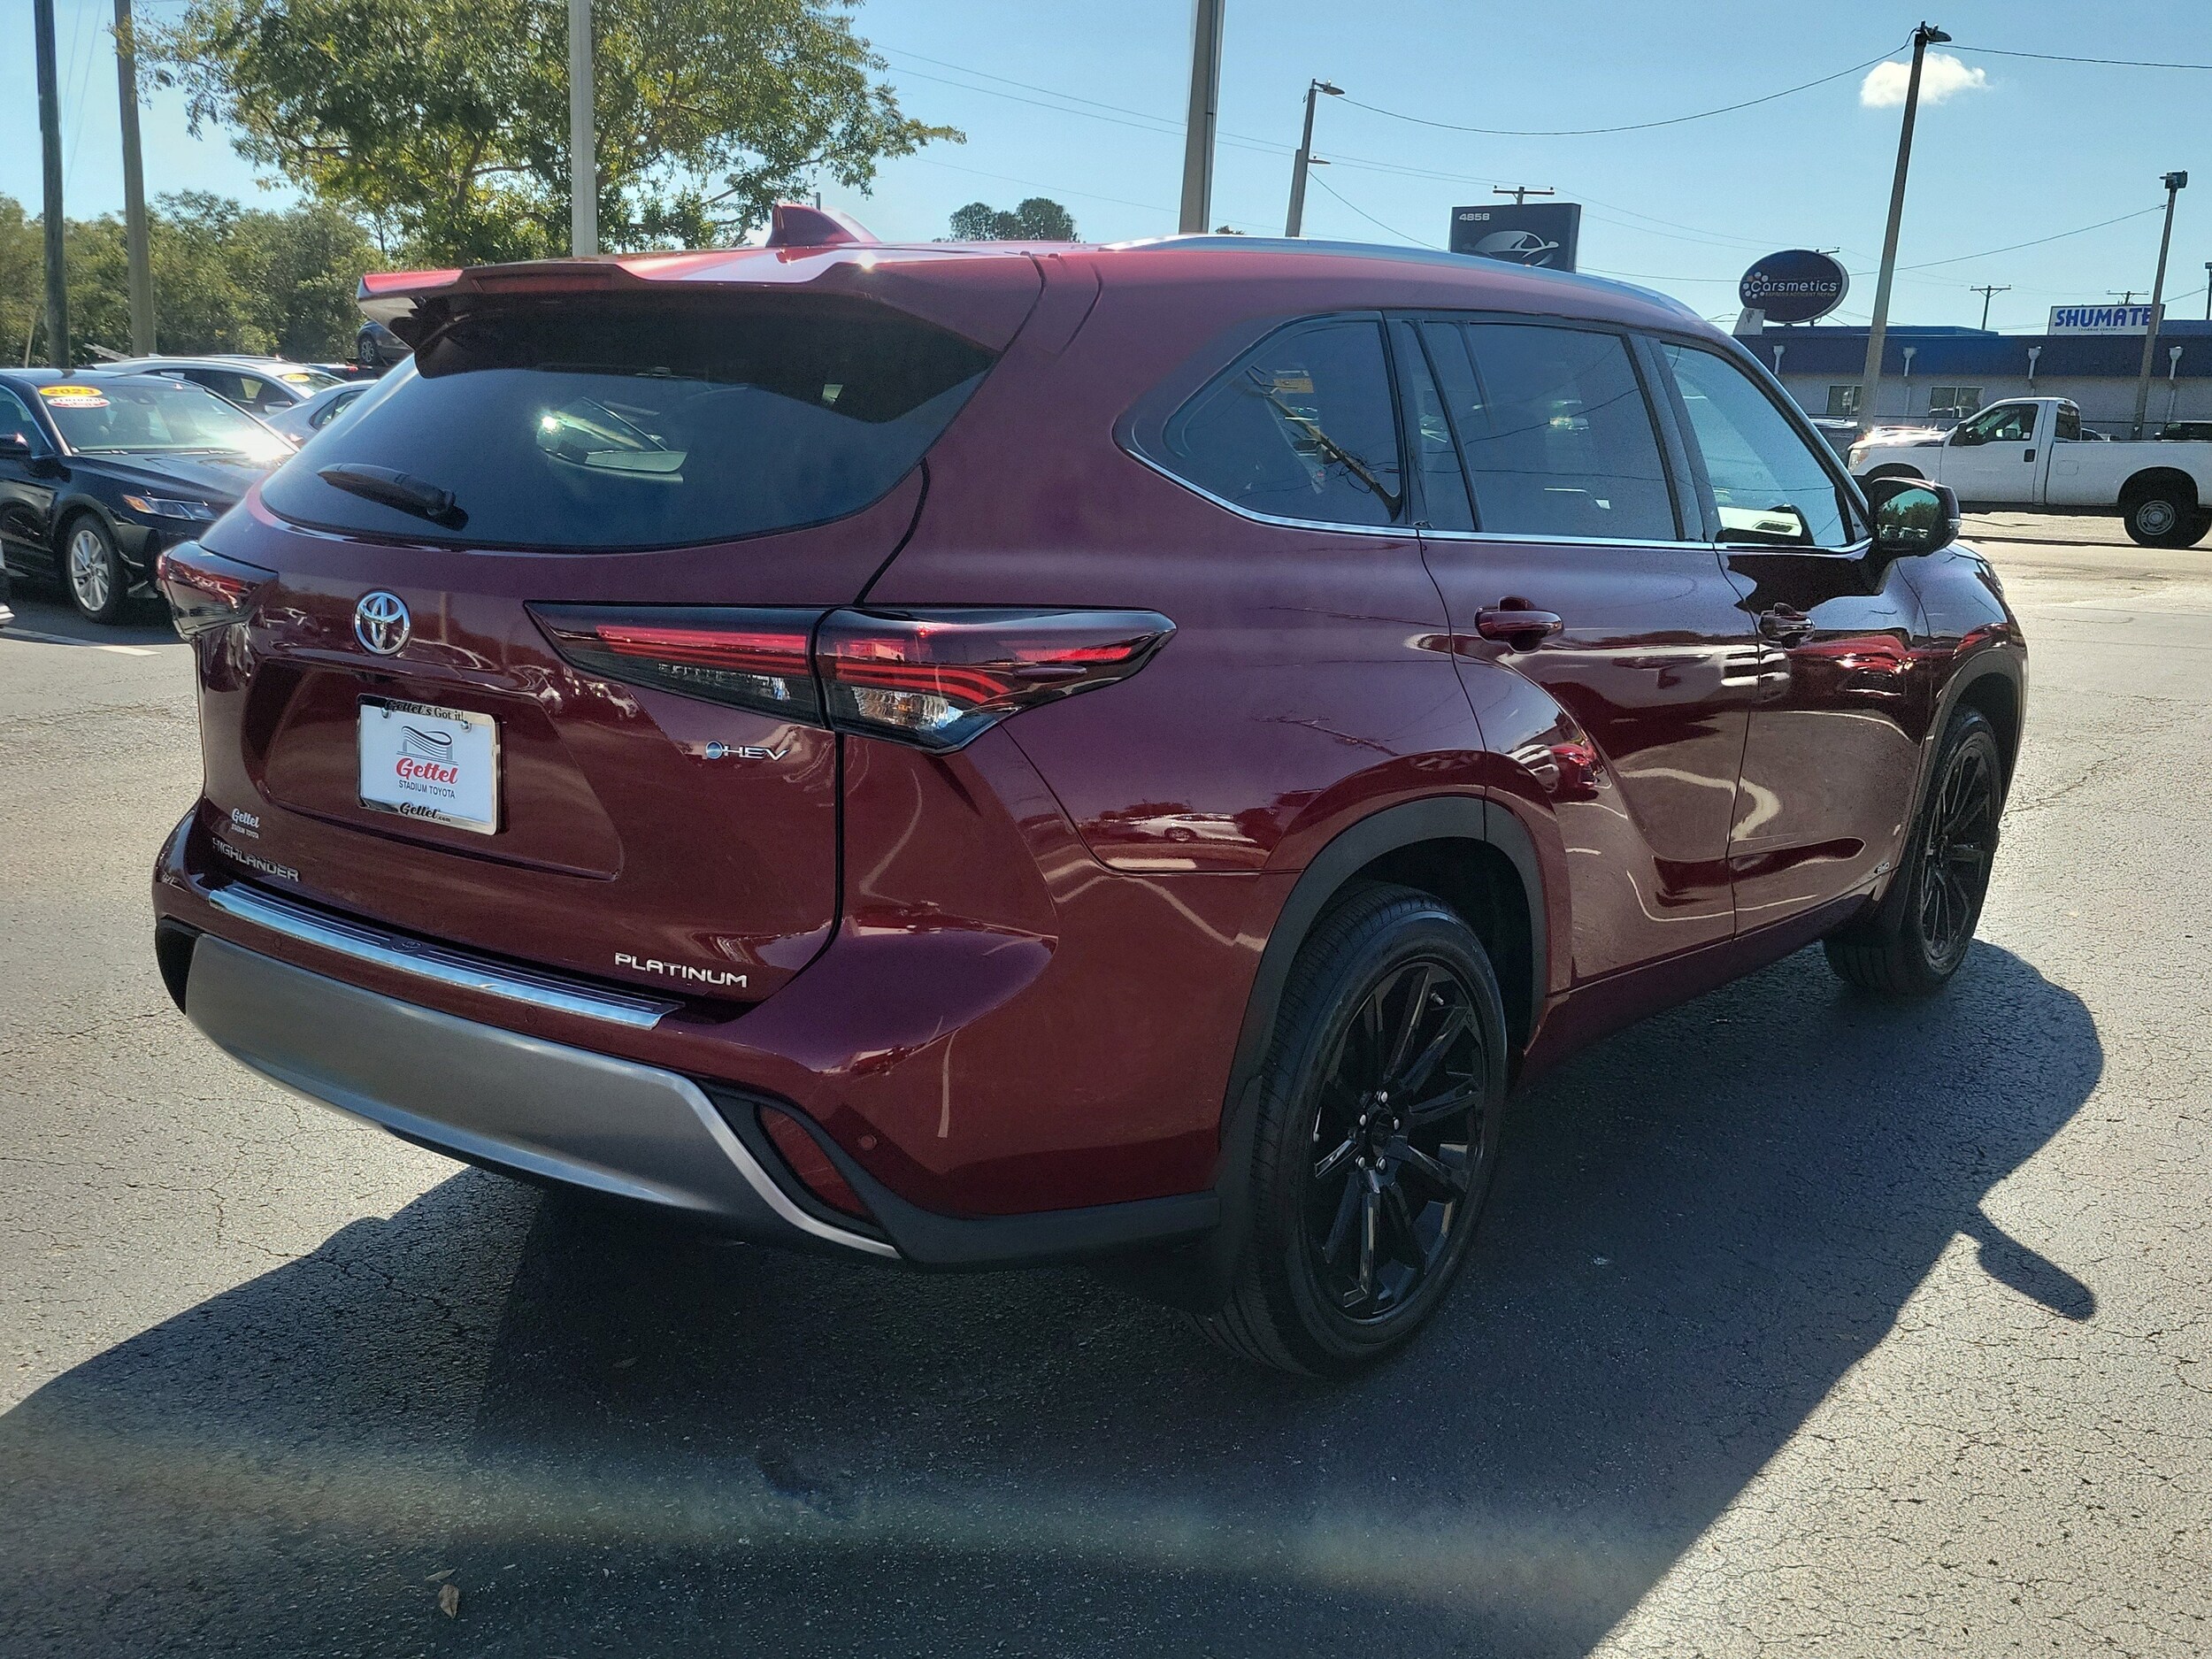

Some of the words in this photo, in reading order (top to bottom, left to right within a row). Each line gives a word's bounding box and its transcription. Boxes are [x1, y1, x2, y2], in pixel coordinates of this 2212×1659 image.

[1458, 212, 1490, 221] 4858
[1750, 280, 1837, 292] Carsmetics
[2055, 307, 2152, 327] SHUMATE
[386, 699, 434, 717] Gettel's
[434, 707, 451, 720] Got
[453, 710, 465, 722] it!
[724, 744, 790, 762] HEV
[396, 757, 459, 785] Gettel
[398, 780, 427, 795] STADIUM
[429, 785, 456, 799] TOYOTA
[231, 807, 260, 829] Gettel
[211, 836, 300, 882] HIGHLANDER
[614, 951, 748, 988] PLATINUM
